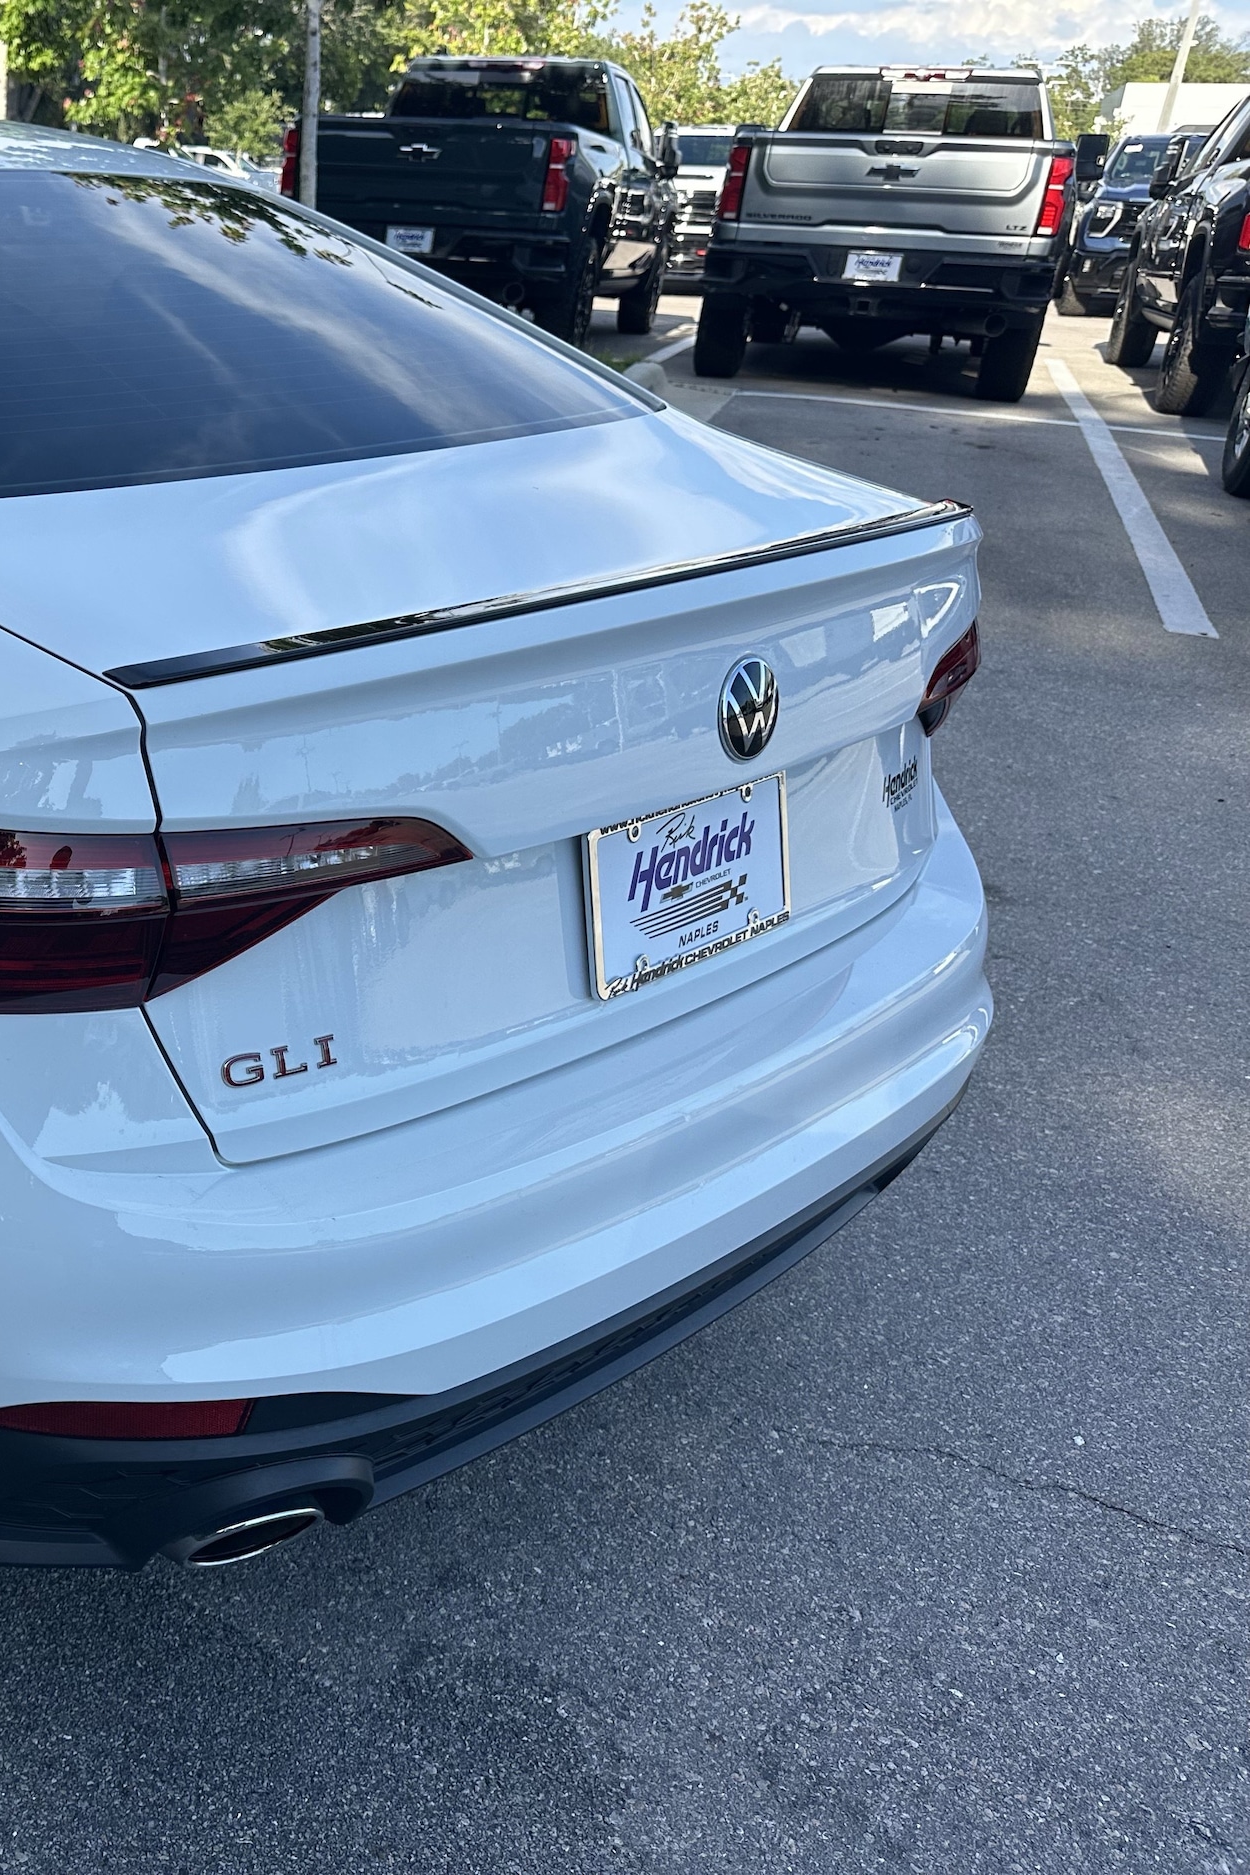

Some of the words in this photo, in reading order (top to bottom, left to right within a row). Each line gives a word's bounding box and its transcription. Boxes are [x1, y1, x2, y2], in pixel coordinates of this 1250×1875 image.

[882, 755, 917, 808] Hendrick
[628, 811, 755, 913] Hendrick
[695, 868, 732, 889] CHEVROLET
[629, 954, 685, 991] Hendrick
[685, 929, 749, 966] CHEVROLET
[750, 910, 790, 937] NAPLES
[678, 920, 719, 948] NAPLES
[221, 1034, 337, 1088] GLI
